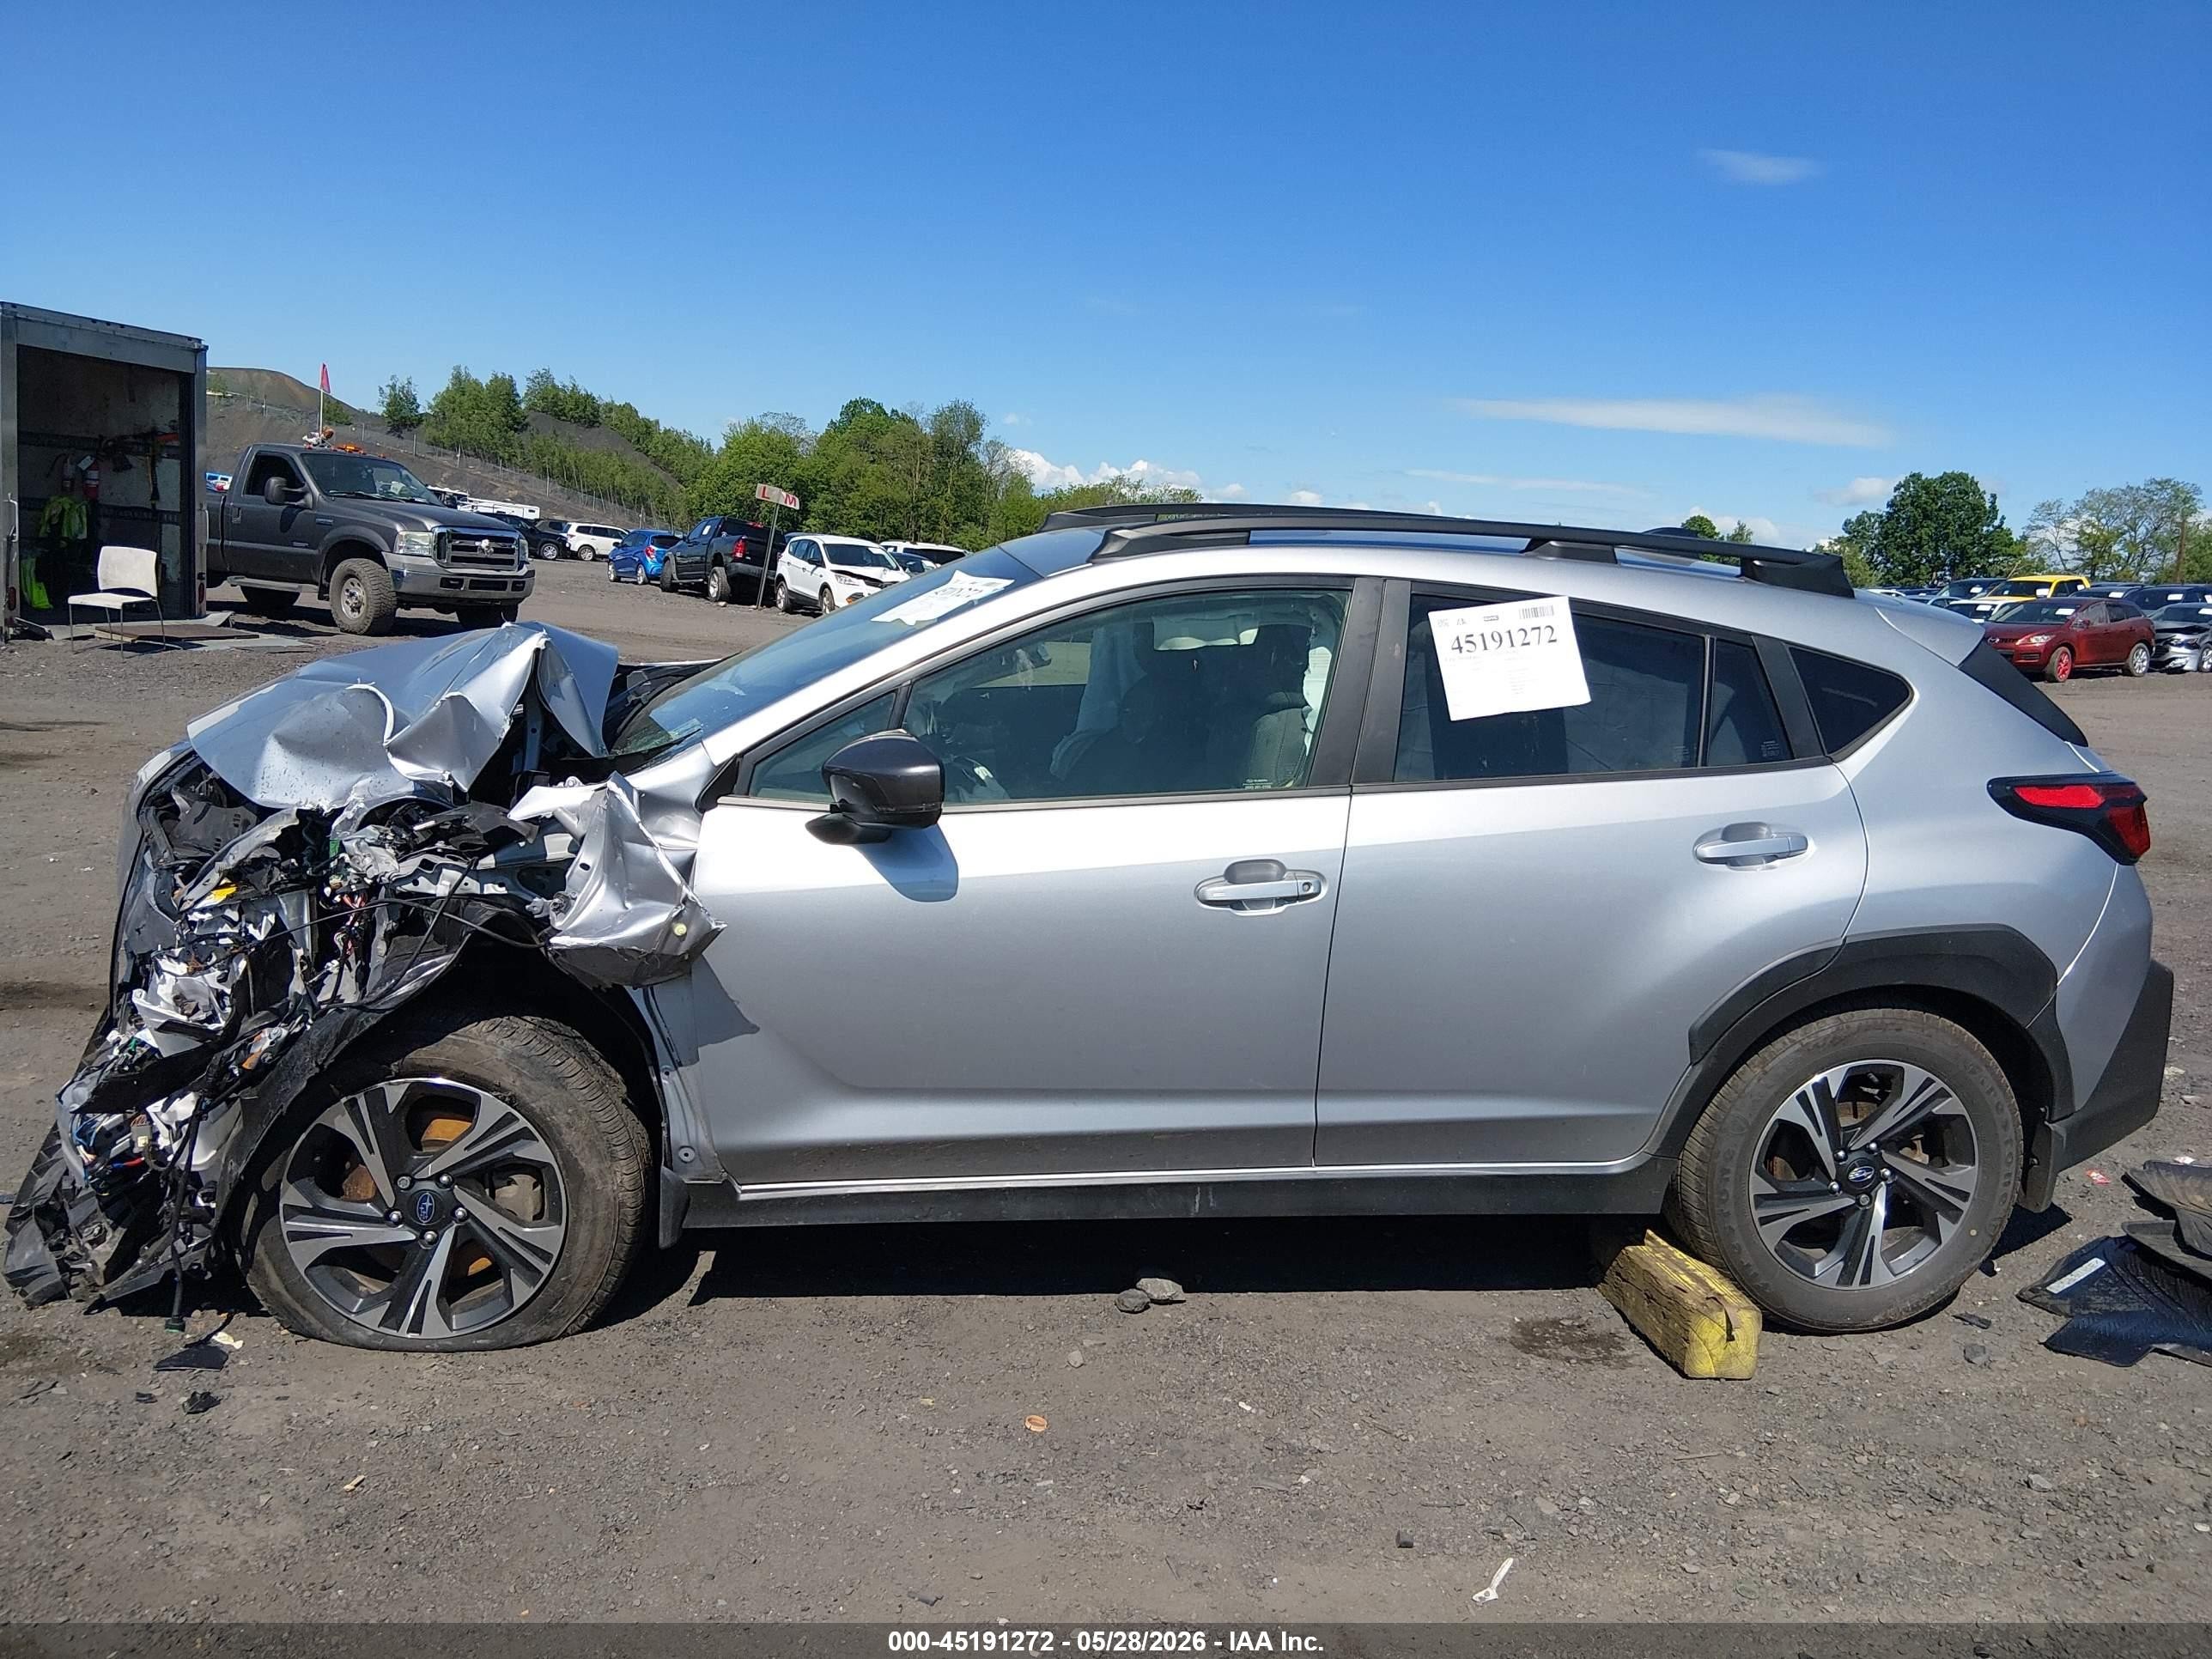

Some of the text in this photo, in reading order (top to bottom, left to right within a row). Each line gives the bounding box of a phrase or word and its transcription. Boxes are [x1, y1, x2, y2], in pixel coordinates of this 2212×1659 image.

[761, 485, 797, 507] L M
[1450, 624, 1557, 653] 45191272
